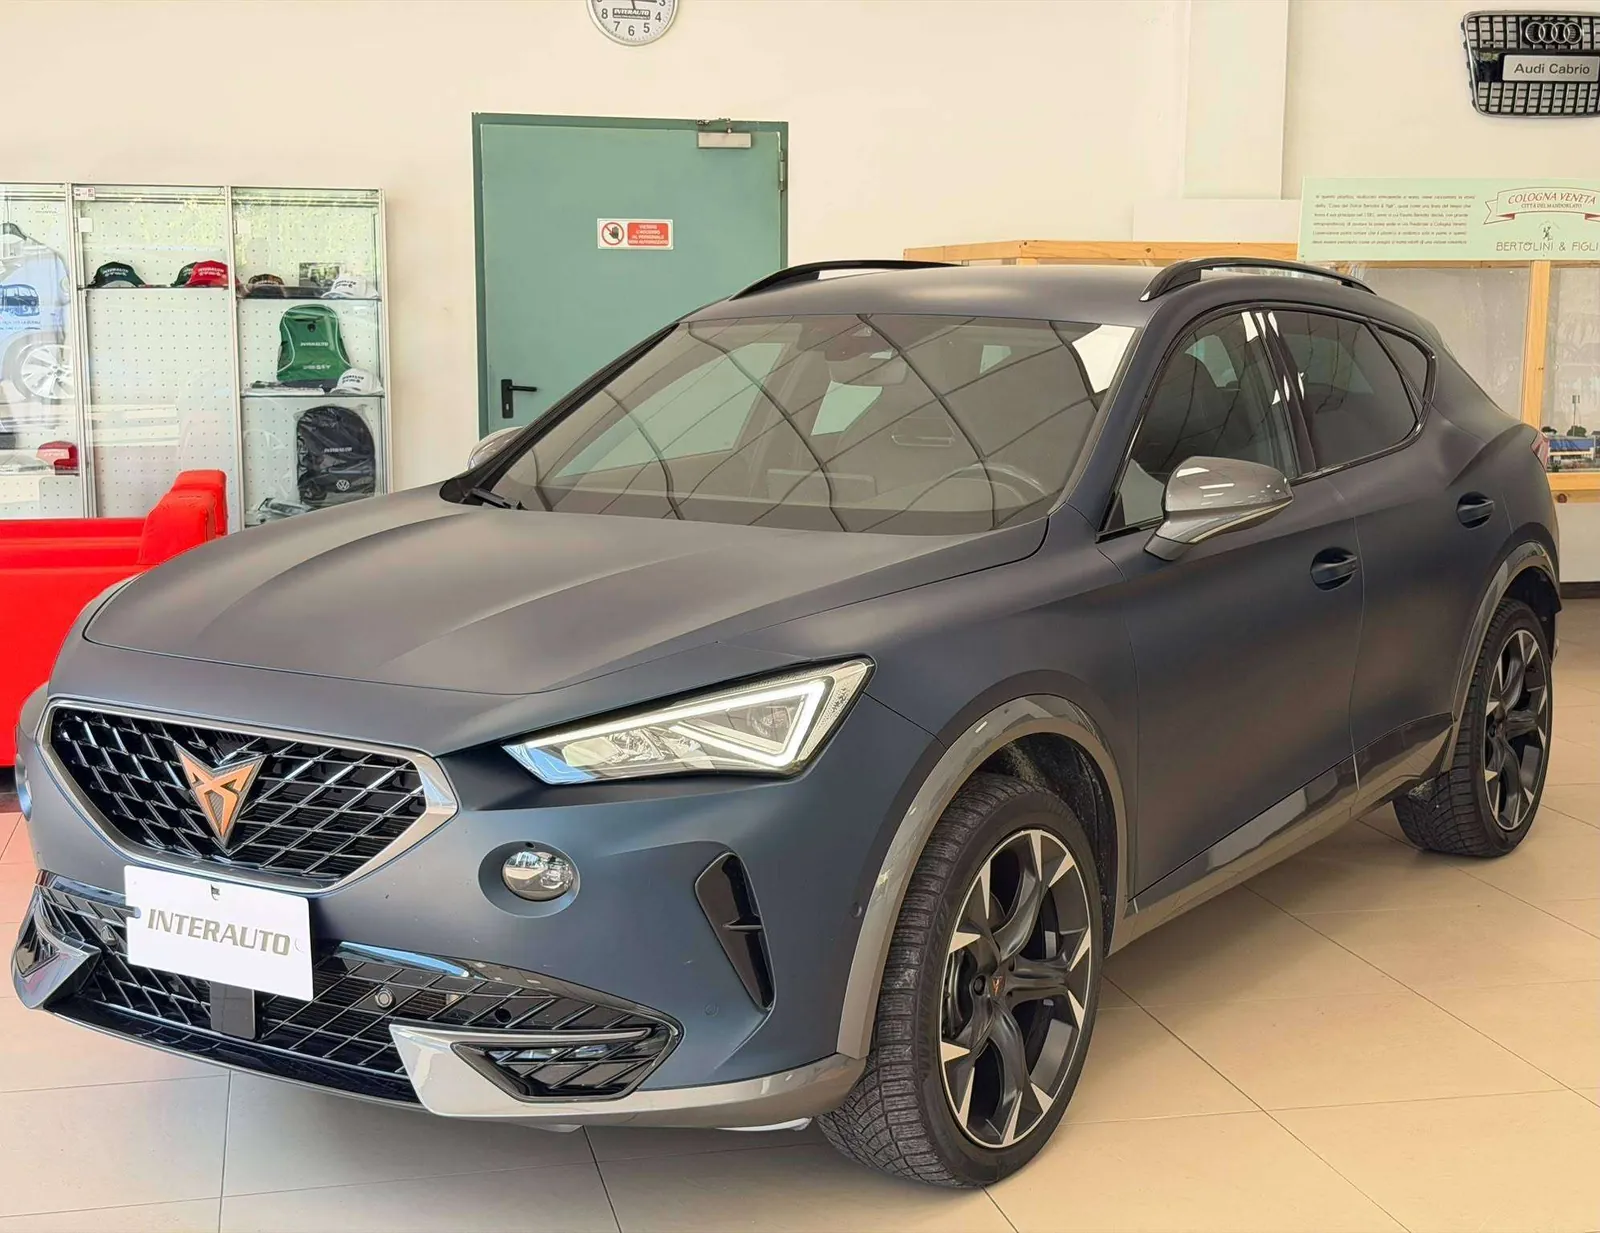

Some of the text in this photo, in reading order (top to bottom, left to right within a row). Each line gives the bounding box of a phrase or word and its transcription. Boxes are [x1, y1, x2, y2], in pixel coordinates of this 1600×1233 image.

[601, 8, 608, 19] 8
[655, 12, 662, 22] 4
[613, 21, 620, 31] 7
[627, 25, 635, 36] 6
[643, 23, 650, 33] 5
[1513, 63, 1590, 75] Audi Cabrio
[1508, 192, 1596, 205] COLOGNA VENETA
[1496, 241, 1599, 252] BERTOLINI & FIGLI
[147, 908, 291, 956] INTERAUTO
